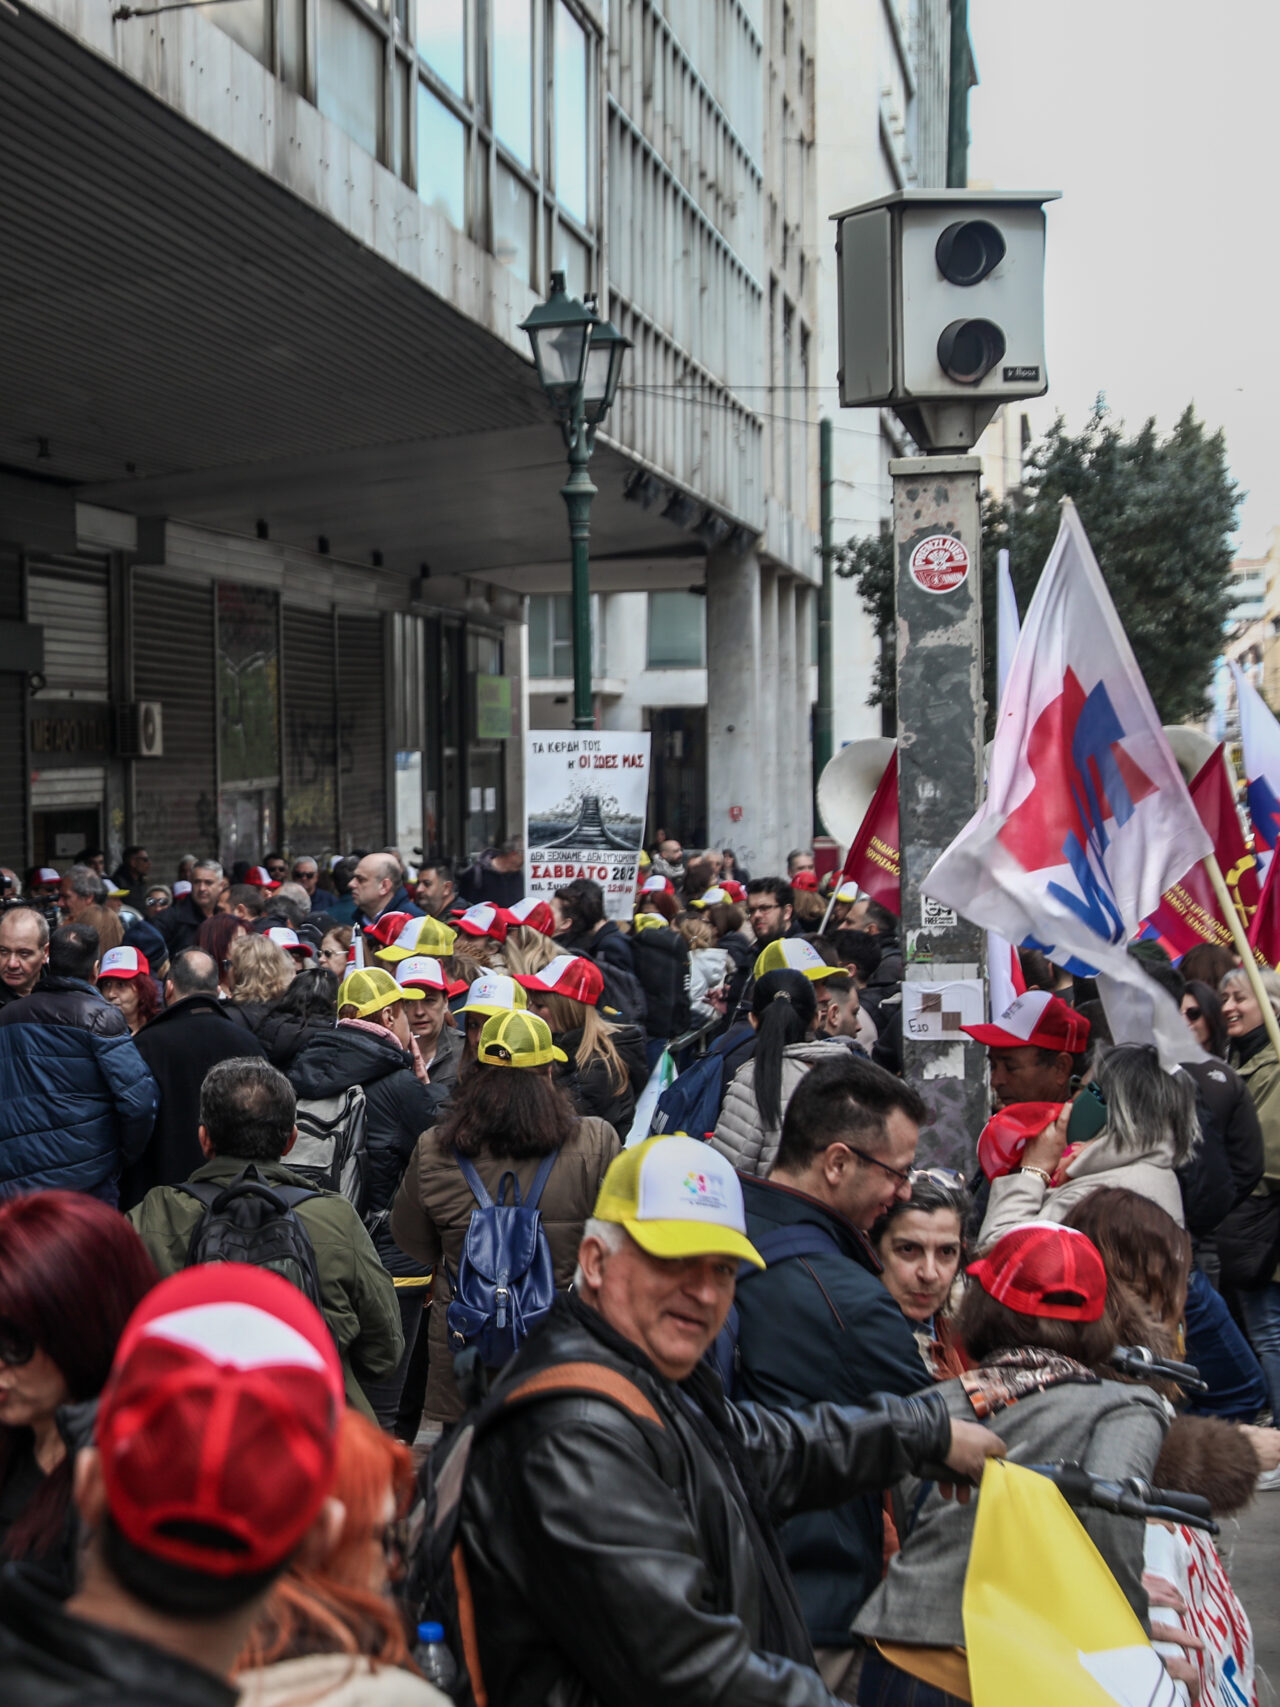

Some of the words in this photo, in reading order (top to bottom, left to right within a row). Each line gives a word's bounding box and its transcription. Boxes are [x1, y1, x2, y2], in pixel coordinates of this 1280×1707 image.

[532, 742, 544, 753] ΤΑ
[579, 755, 590, 769] ΟΙ
[530, 851, 545, 861] ΔΕΝ
[531, 864, 608, 880] ΣΑΒΒΑΤΟ
[612, 866, 635, 881] 28/2
